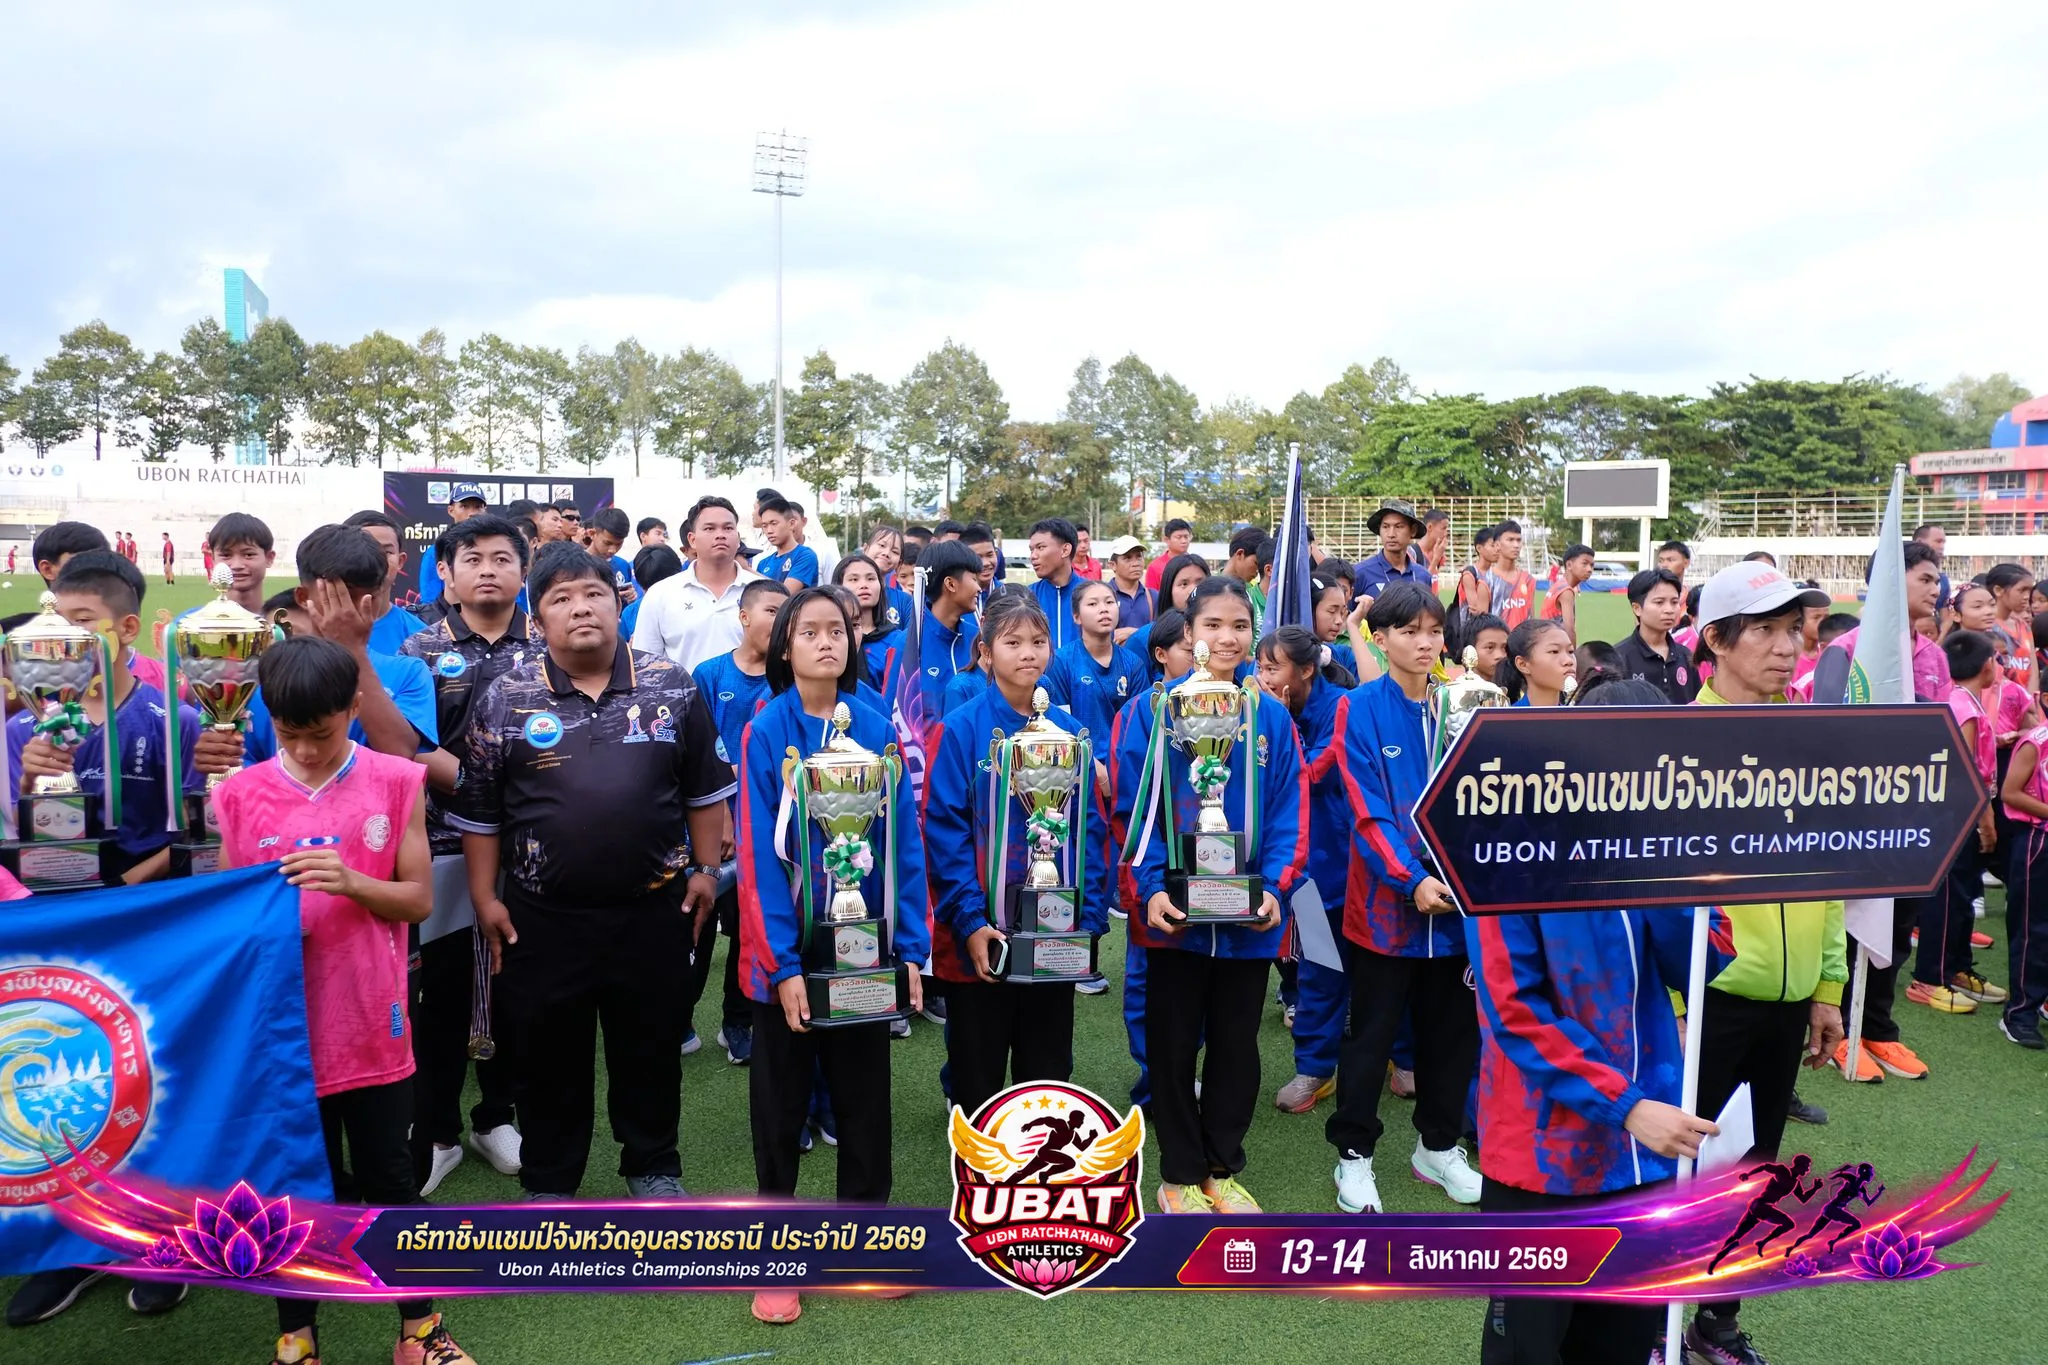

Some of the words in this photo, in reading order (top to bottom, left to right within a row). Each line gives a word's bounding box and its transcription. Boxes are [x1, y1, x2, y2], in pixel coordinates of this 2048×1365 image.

[137, 466, 190, 482] UBON
[1502, 598, 1526, 609] KNP
[1456, 749, 1949, 823] กรีฑาชิงแชมป์จังหวัดอุบลราชธานี
[1474, 840, 1556, 863] UBON
[1568, 835, 1718, 860] ATHLETICS
[1730, 827, 1931, 854] CHAMPIONSHIPS
